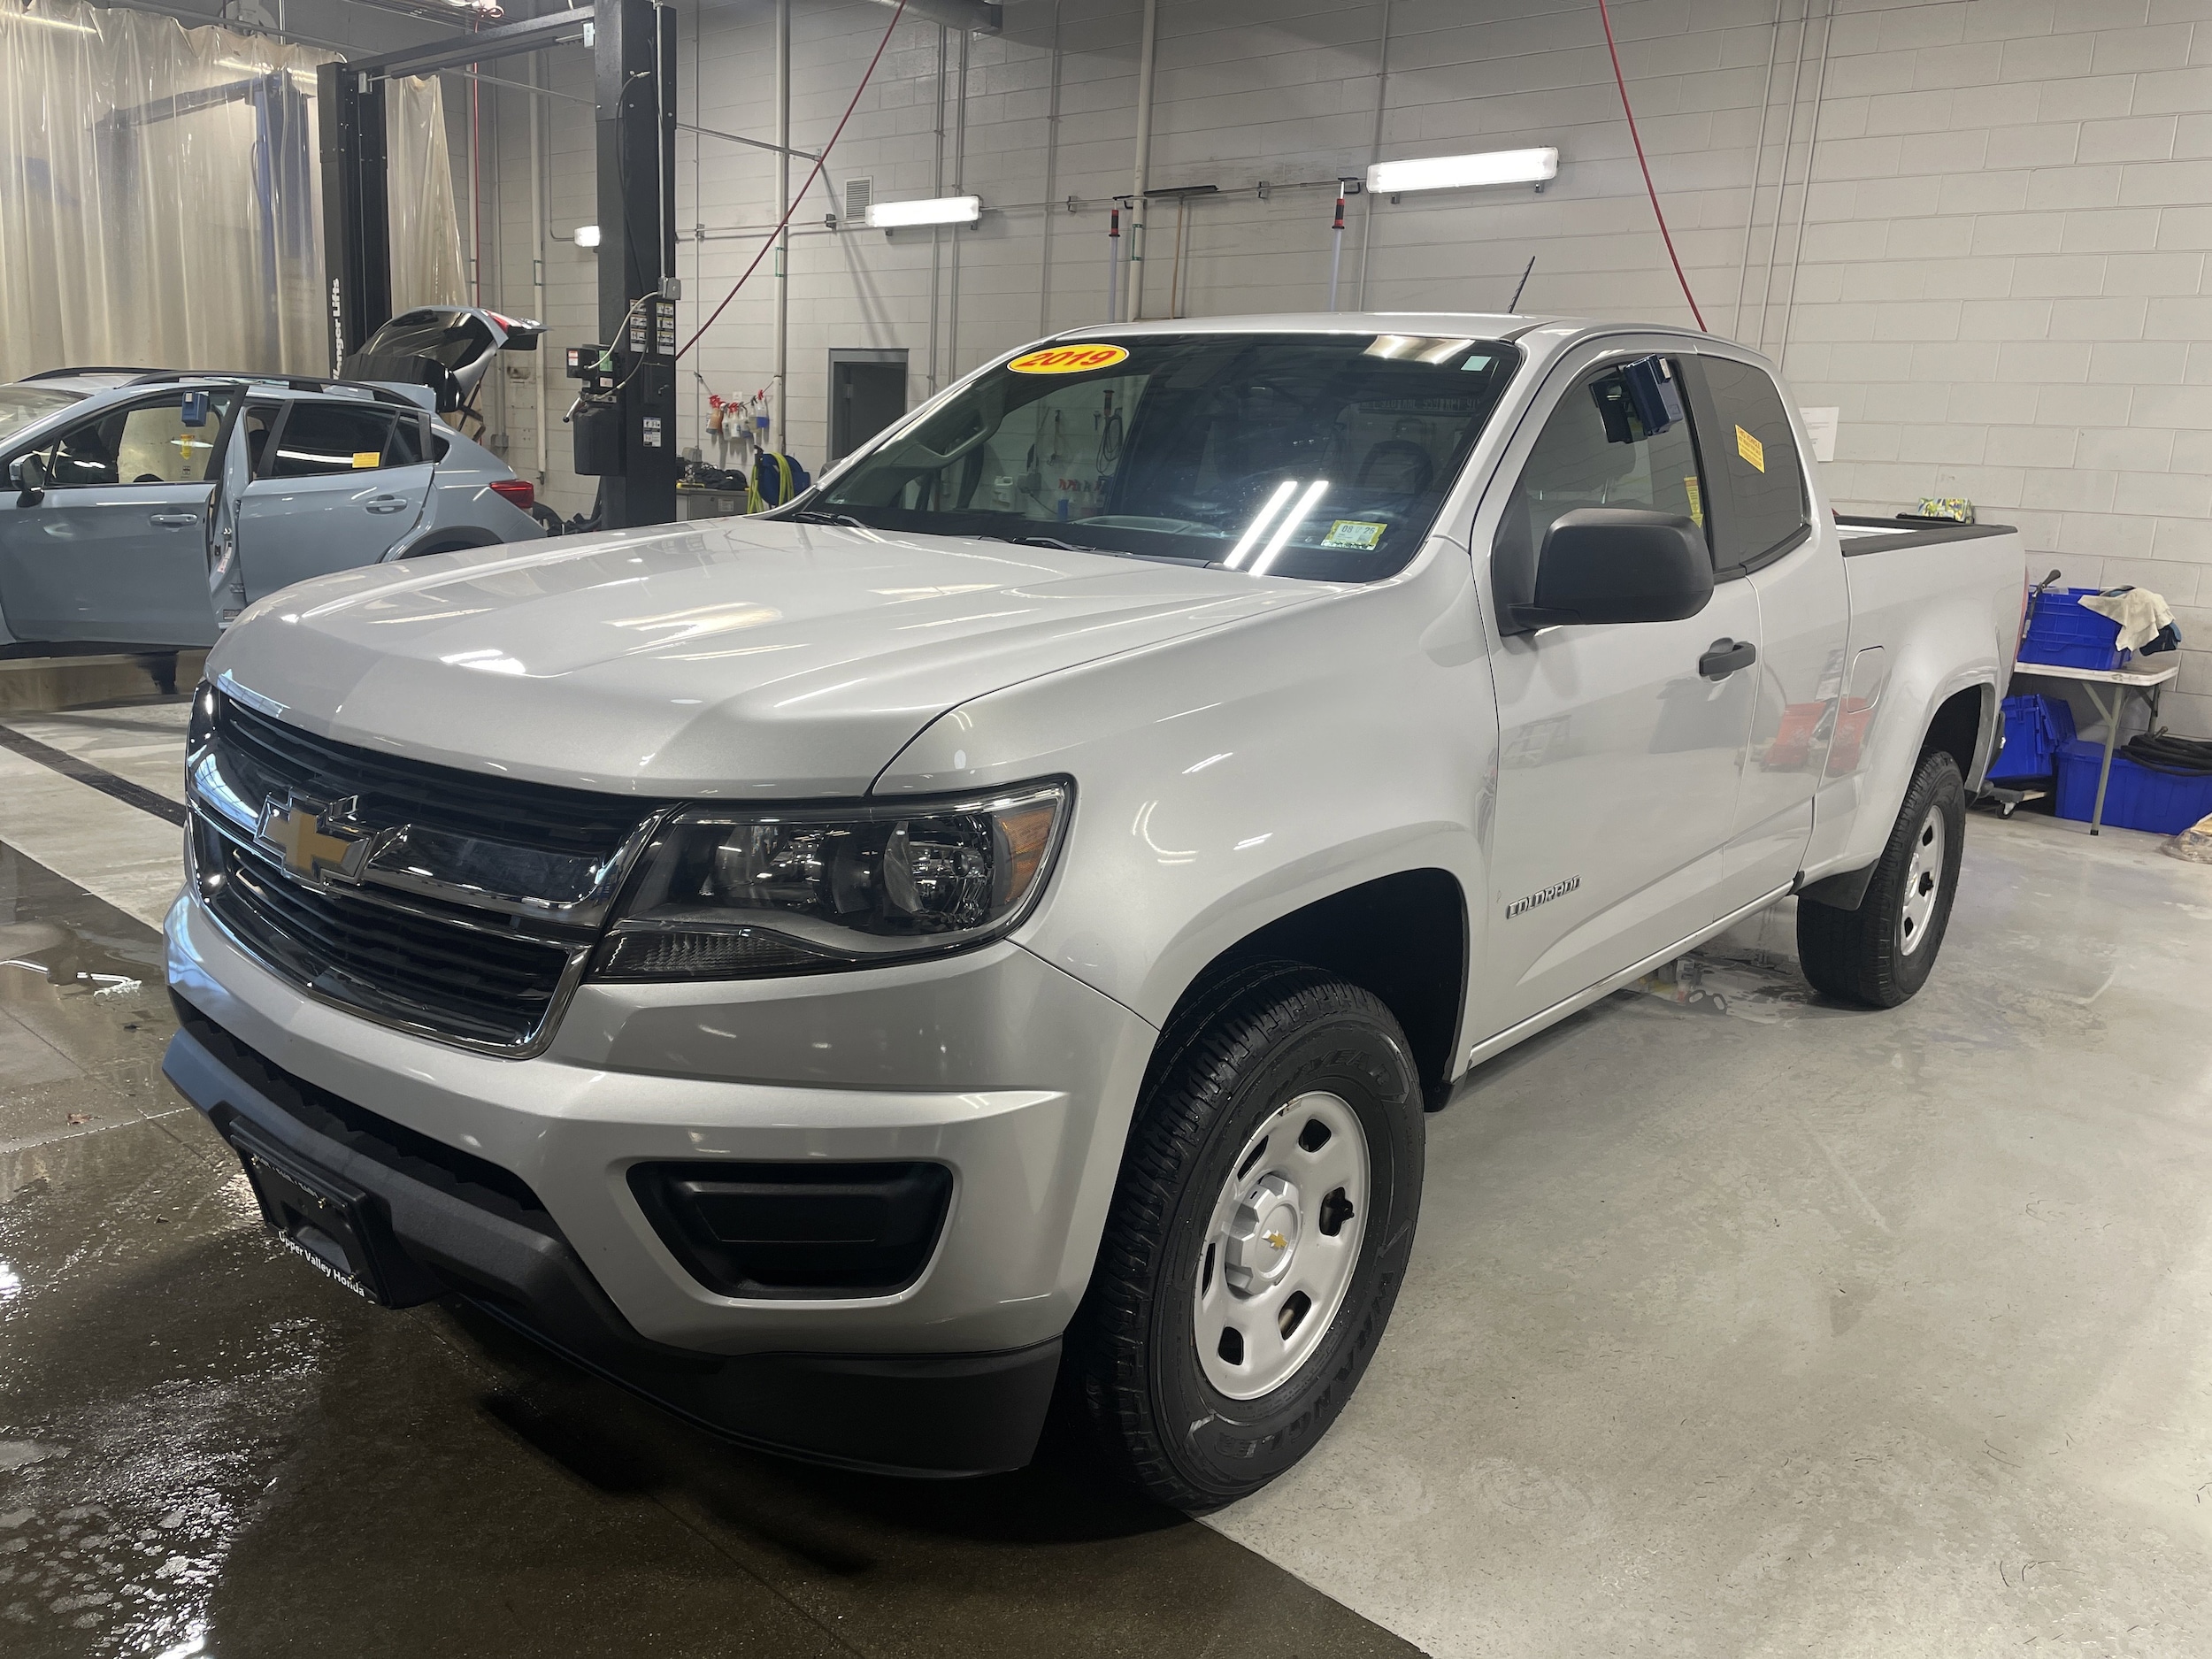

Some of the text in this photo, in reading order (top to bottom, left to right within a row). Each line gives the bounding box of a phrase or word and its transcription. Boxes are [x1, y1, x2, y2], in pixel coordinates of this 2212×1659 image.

[1014, 350, 1118, 367] 2019
[1341, 525, 1354, 534] 08
[1505, 874, 1582, 920] COLORADO
[278, 1230, 365, 1298] Upper Valley Honda
